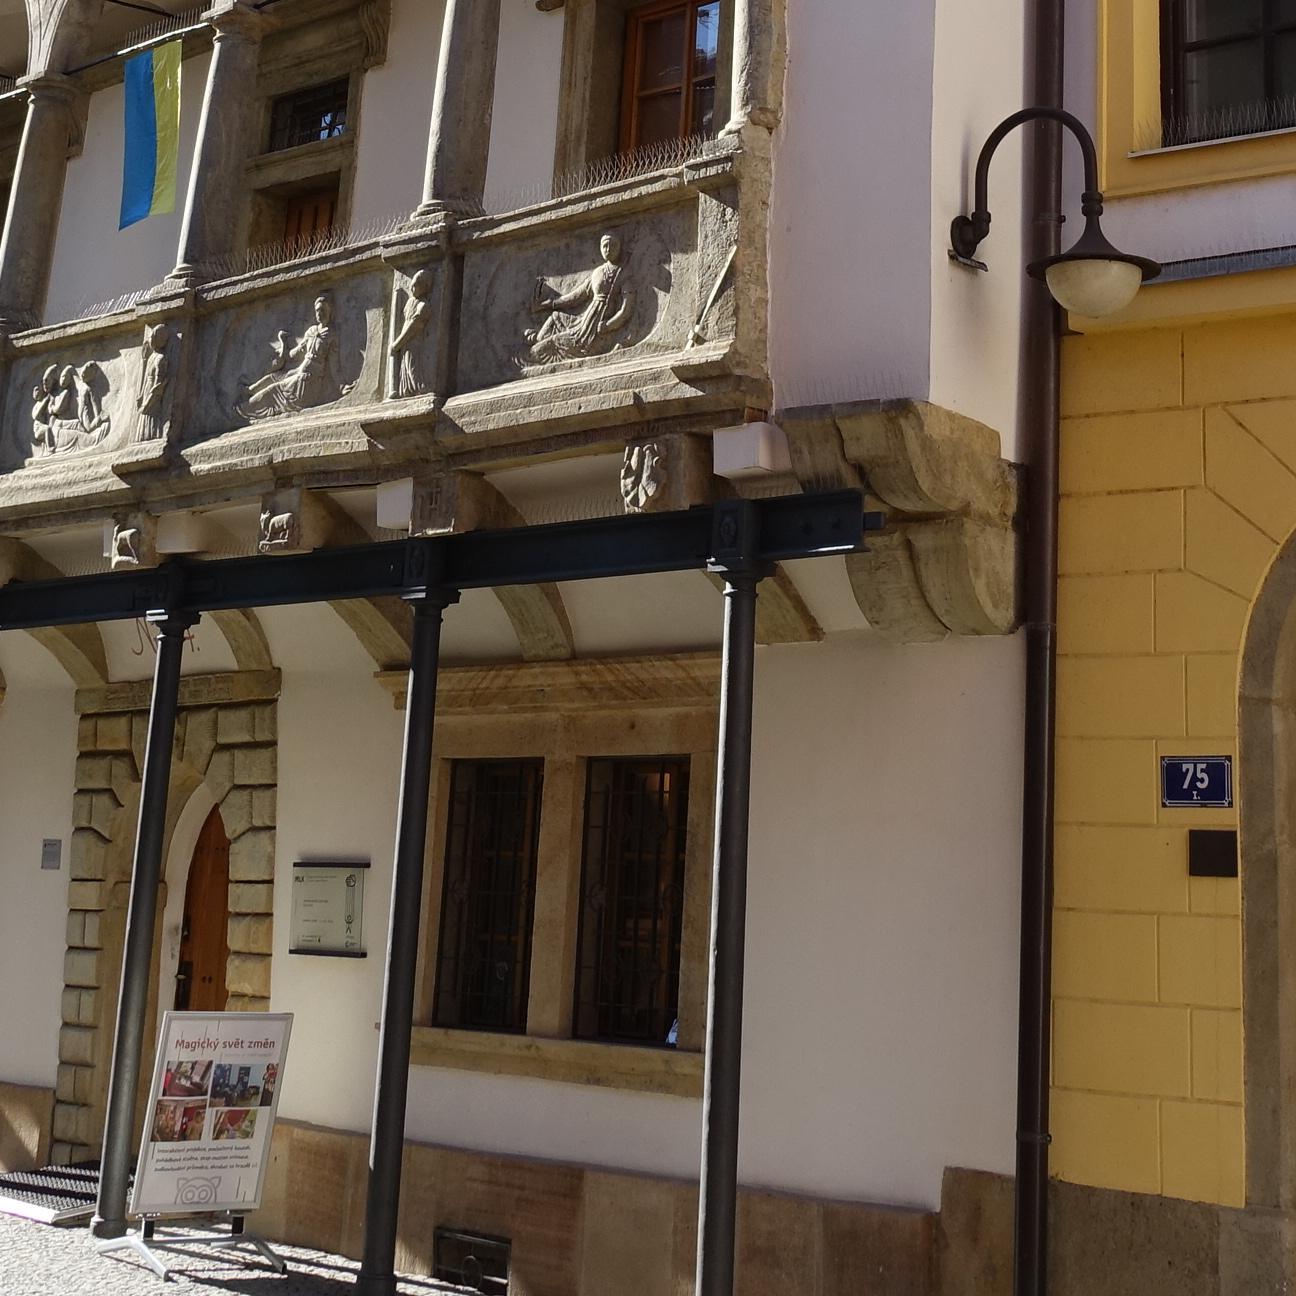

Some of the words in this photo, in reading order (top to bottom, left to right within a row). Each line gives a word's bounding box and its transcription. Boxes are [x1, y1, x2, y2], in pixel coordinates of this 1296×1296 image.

[1181, 763, 1209, 789] 75
[1192, 790, 1201, 800] I.
[175, 1038, 219, 1052] Magický
[222, 1037, 245, 1049] svět
[247, 1038, 276, 1049] změn
